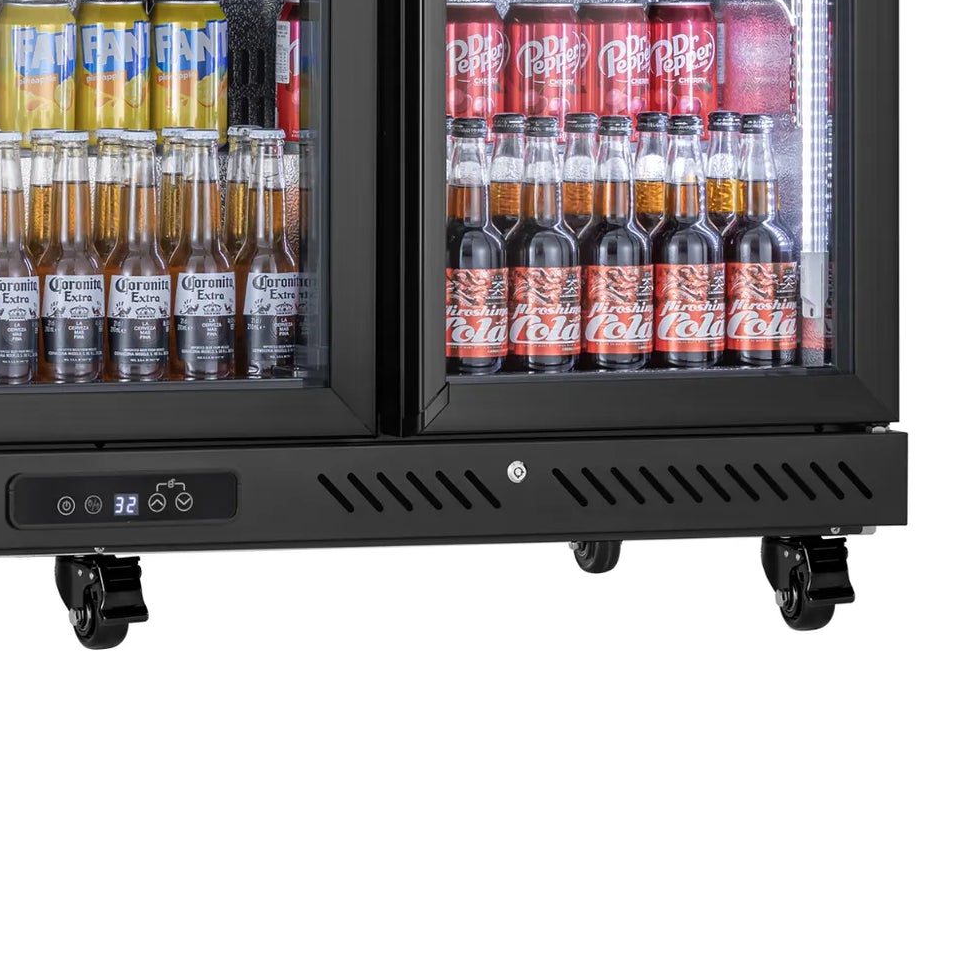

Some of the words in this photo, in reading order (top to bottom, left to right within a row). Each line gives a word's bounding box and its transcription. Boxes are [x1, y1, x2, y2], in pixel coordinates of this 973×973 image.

[467, 33, 493, 57] Dr
[543, 34, 569, 57] Dr
[626, 34, 647, 55] Dr
[672, 33, 699, 56] Dr
[517, 40, 579, 78] Pepper
[599, 39, 650, 78] Peppe
[651, 39, 712, 77] Pepper
[678, 77, 707, 85] CHERRY
[49, 276, 103, 293] Coronita
[115, 277, 169, 293] Coronita
[181, 275, 234, 292] Coronita
[270, 288, 295, 300] Extra
[2, 292, 30, 304] Extra
[64, 291, 92, 302] Extra
[131, 291, 160, 303] Extra
[197, 289, 224, 300] Extra
[509, 314, 580, 344] Cola
[585, 313, 653, 343] Cola
[657, 311, 725, 340] Cola
[727, 310, 797, 339] Cola
[115, 496, 137, 513] 32
